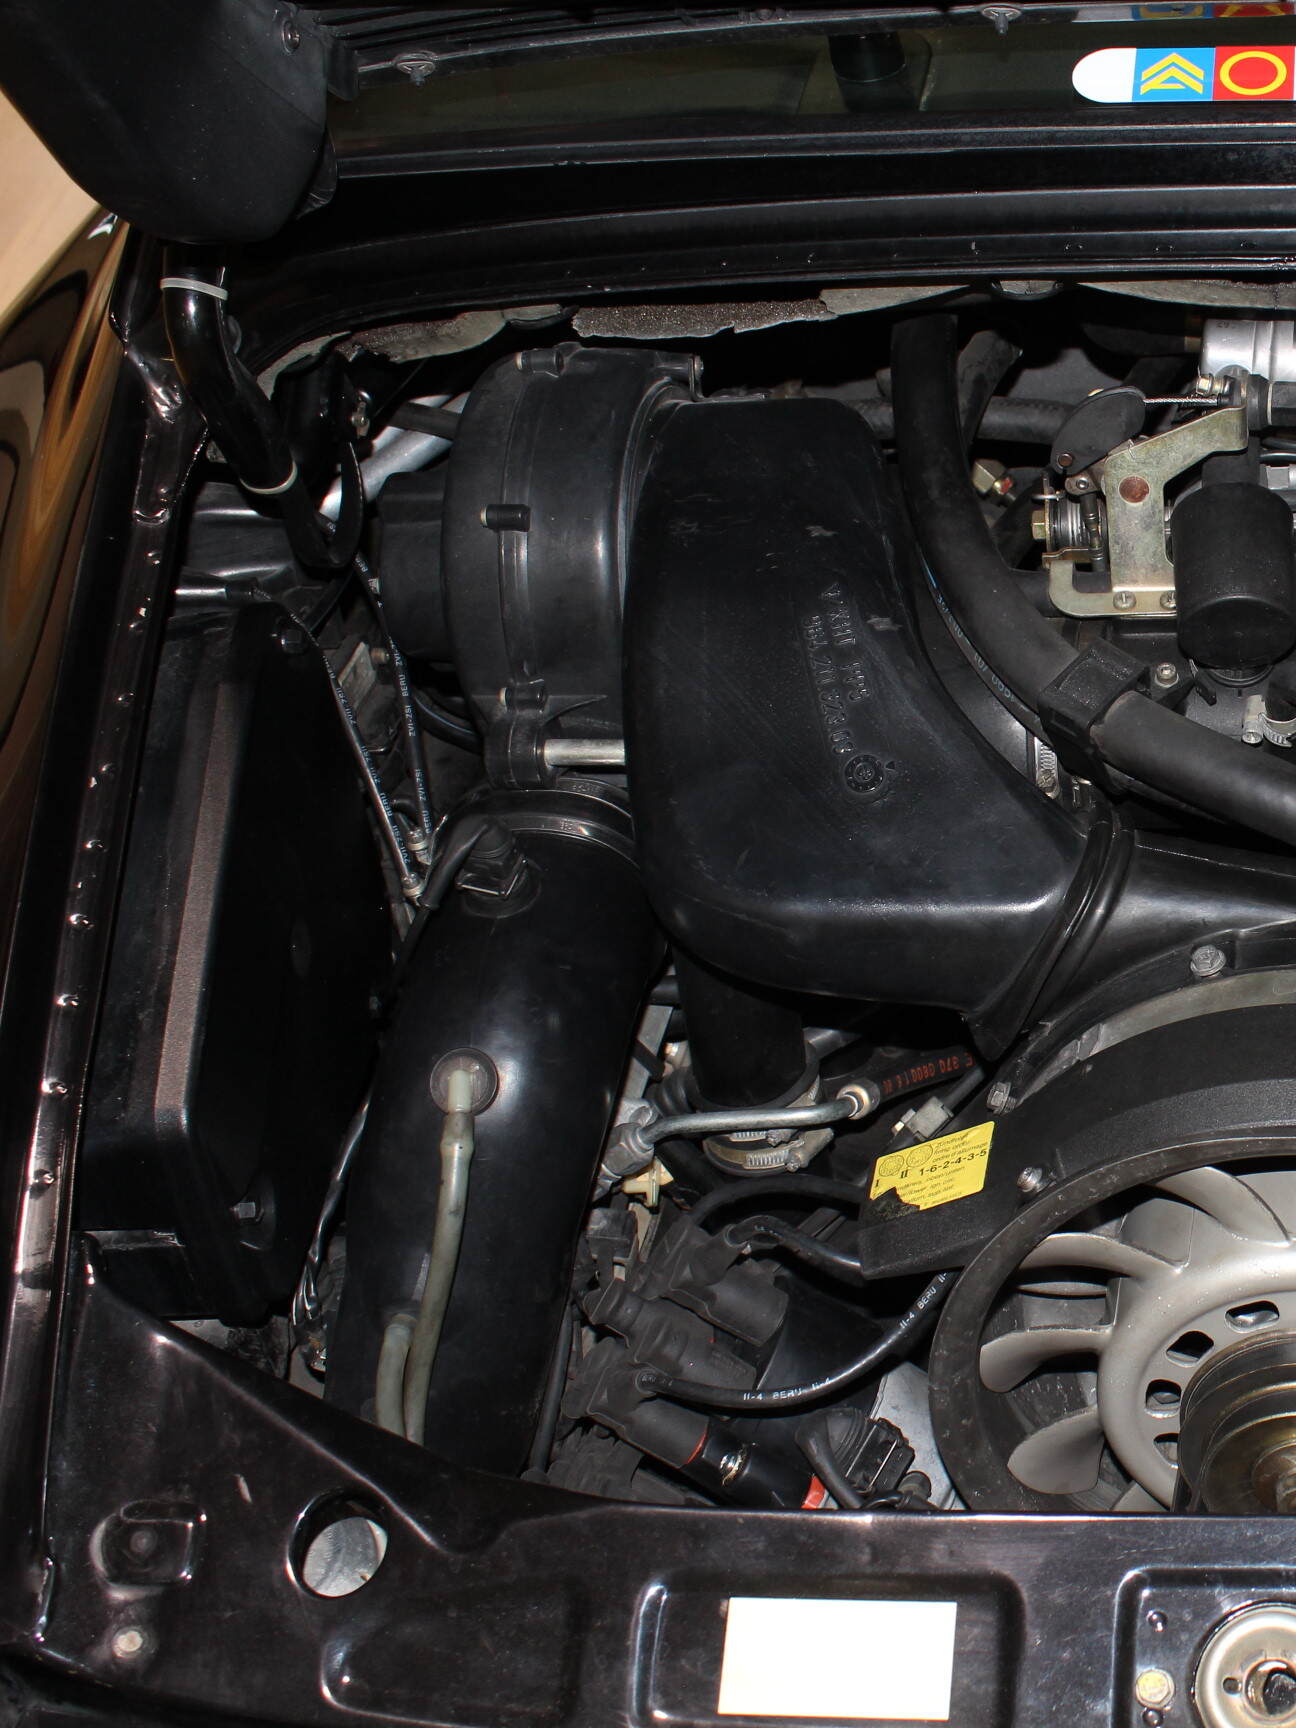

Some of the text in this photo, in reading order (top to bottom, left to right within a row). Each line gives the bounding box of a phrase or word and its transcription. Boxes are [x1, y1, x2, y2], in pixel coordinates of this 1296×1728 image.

[398, 673, 411, 698] BERU
[379, 791, 393, 818] BERU
[919, 1149, 988, 1176] 1-6-2-4-3-5
[900, 1311, 916, 1330] II-4
[916, 1286, 937, 1310] BERU
[743, 1391, 763, 1401] II-4
[772, 1386, 803, 1401] BERU
